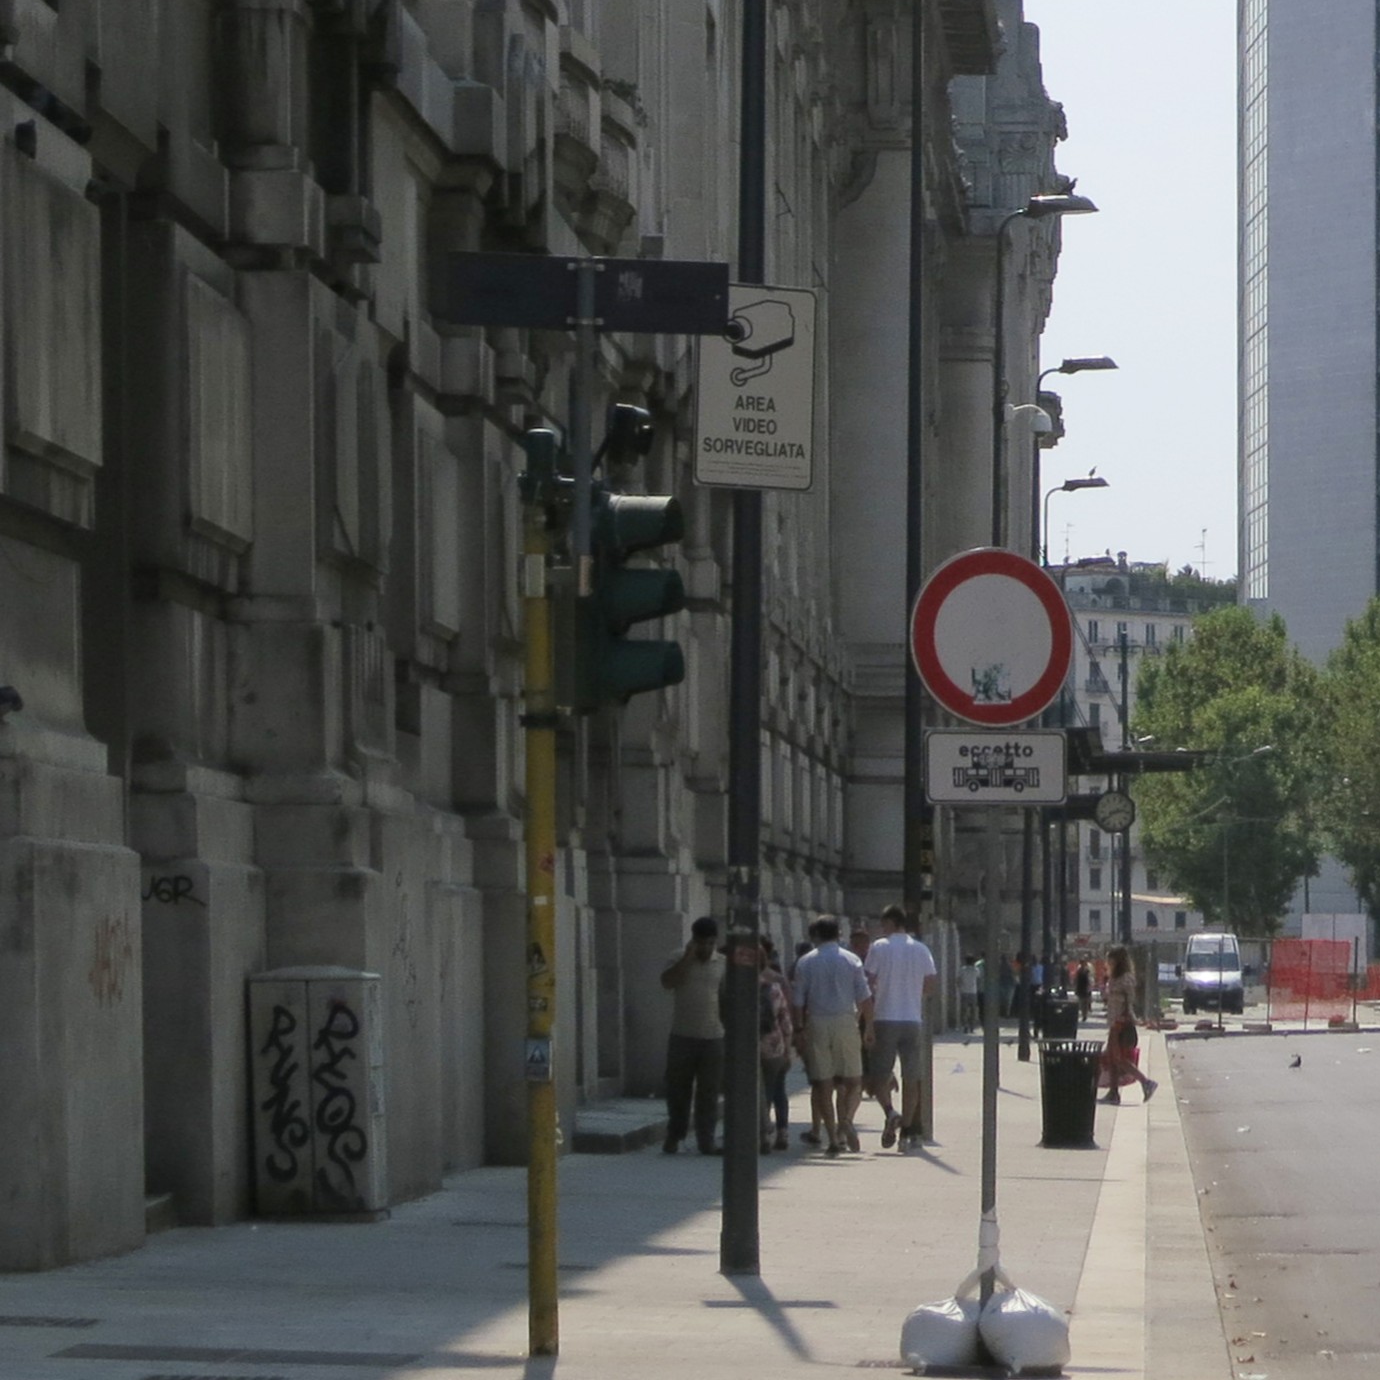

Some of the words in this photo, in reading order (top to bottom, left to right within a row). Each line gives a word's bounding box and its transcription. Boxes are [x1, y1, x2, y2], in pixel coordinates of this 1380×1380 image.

[735, 395, 776, 412] AREA
[732, 417, 777, 435] VIDEO
[703, 437, 805, 459] SORVEGLIATA
[959, 742, 1033, 757] eccetto
